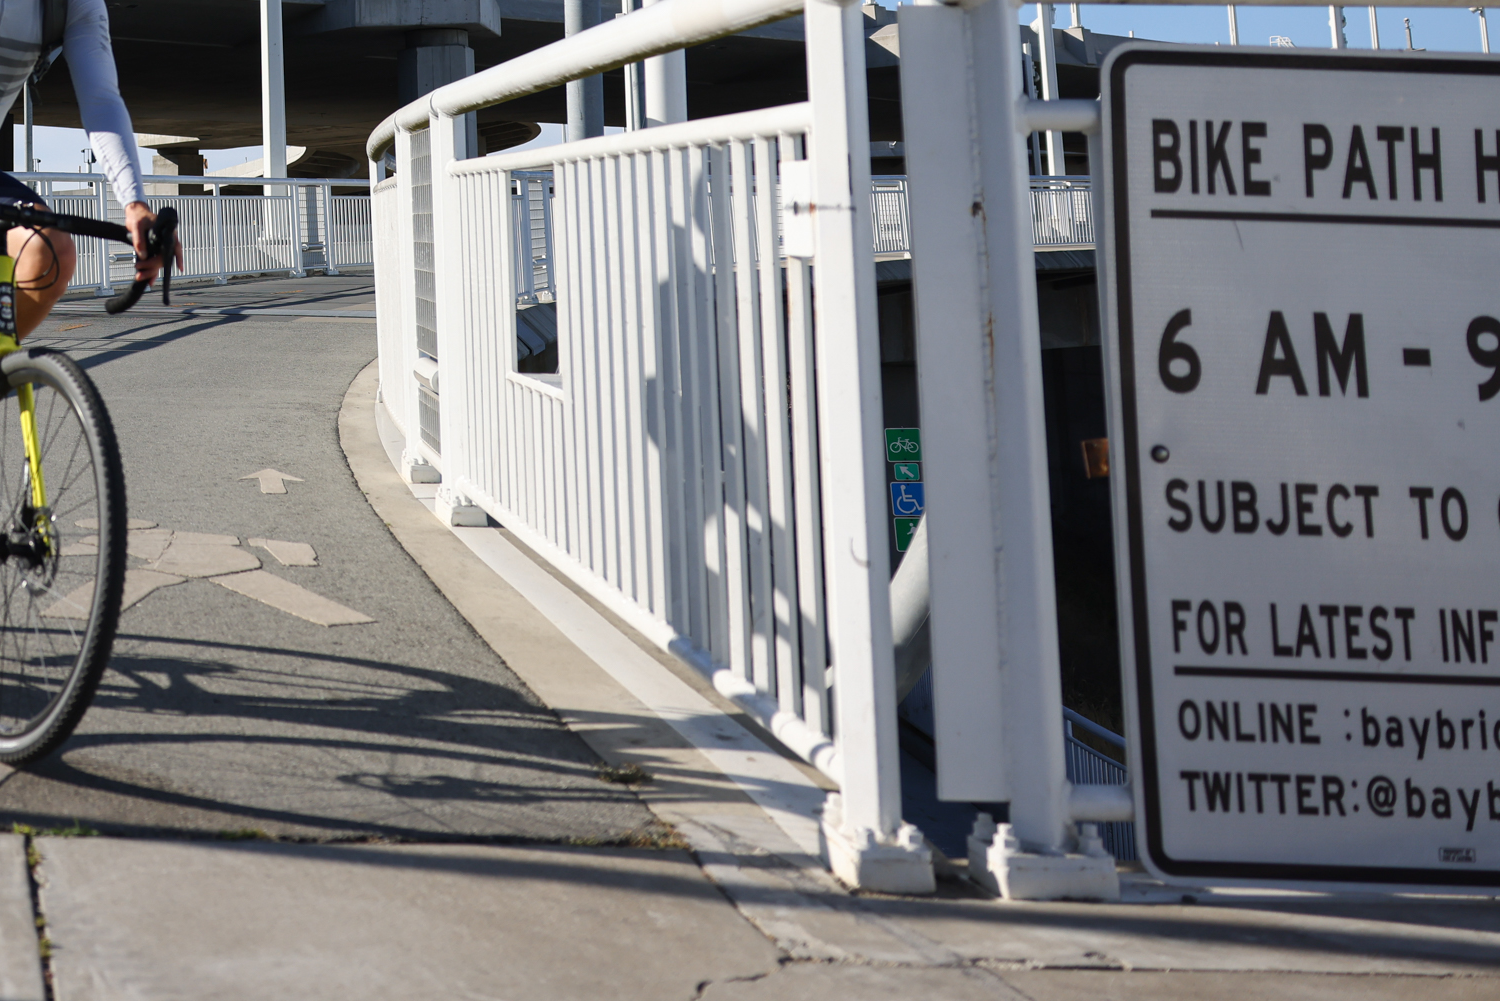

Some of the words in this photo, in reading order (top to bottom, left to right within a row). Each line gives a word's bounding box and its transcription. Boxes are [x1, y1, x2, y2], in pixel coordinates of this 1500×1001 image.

[1151, 118, 1272, 197] BIKE
[1303, 122, 1444, 202] PATH
[1158, 307, 1202, 395] 6
[1255, 310, 1370, 399] AM
[1466, 315, 1500, 403] 9
[1165, 478, 1380, 539] SUBJECT
[1408, 486, 1470, 542] TO
[1171, 599, 1249, 657] FOR
[1270, 602, 1416, 662] LATEST
[1438, 606, 1499, 665] INF
